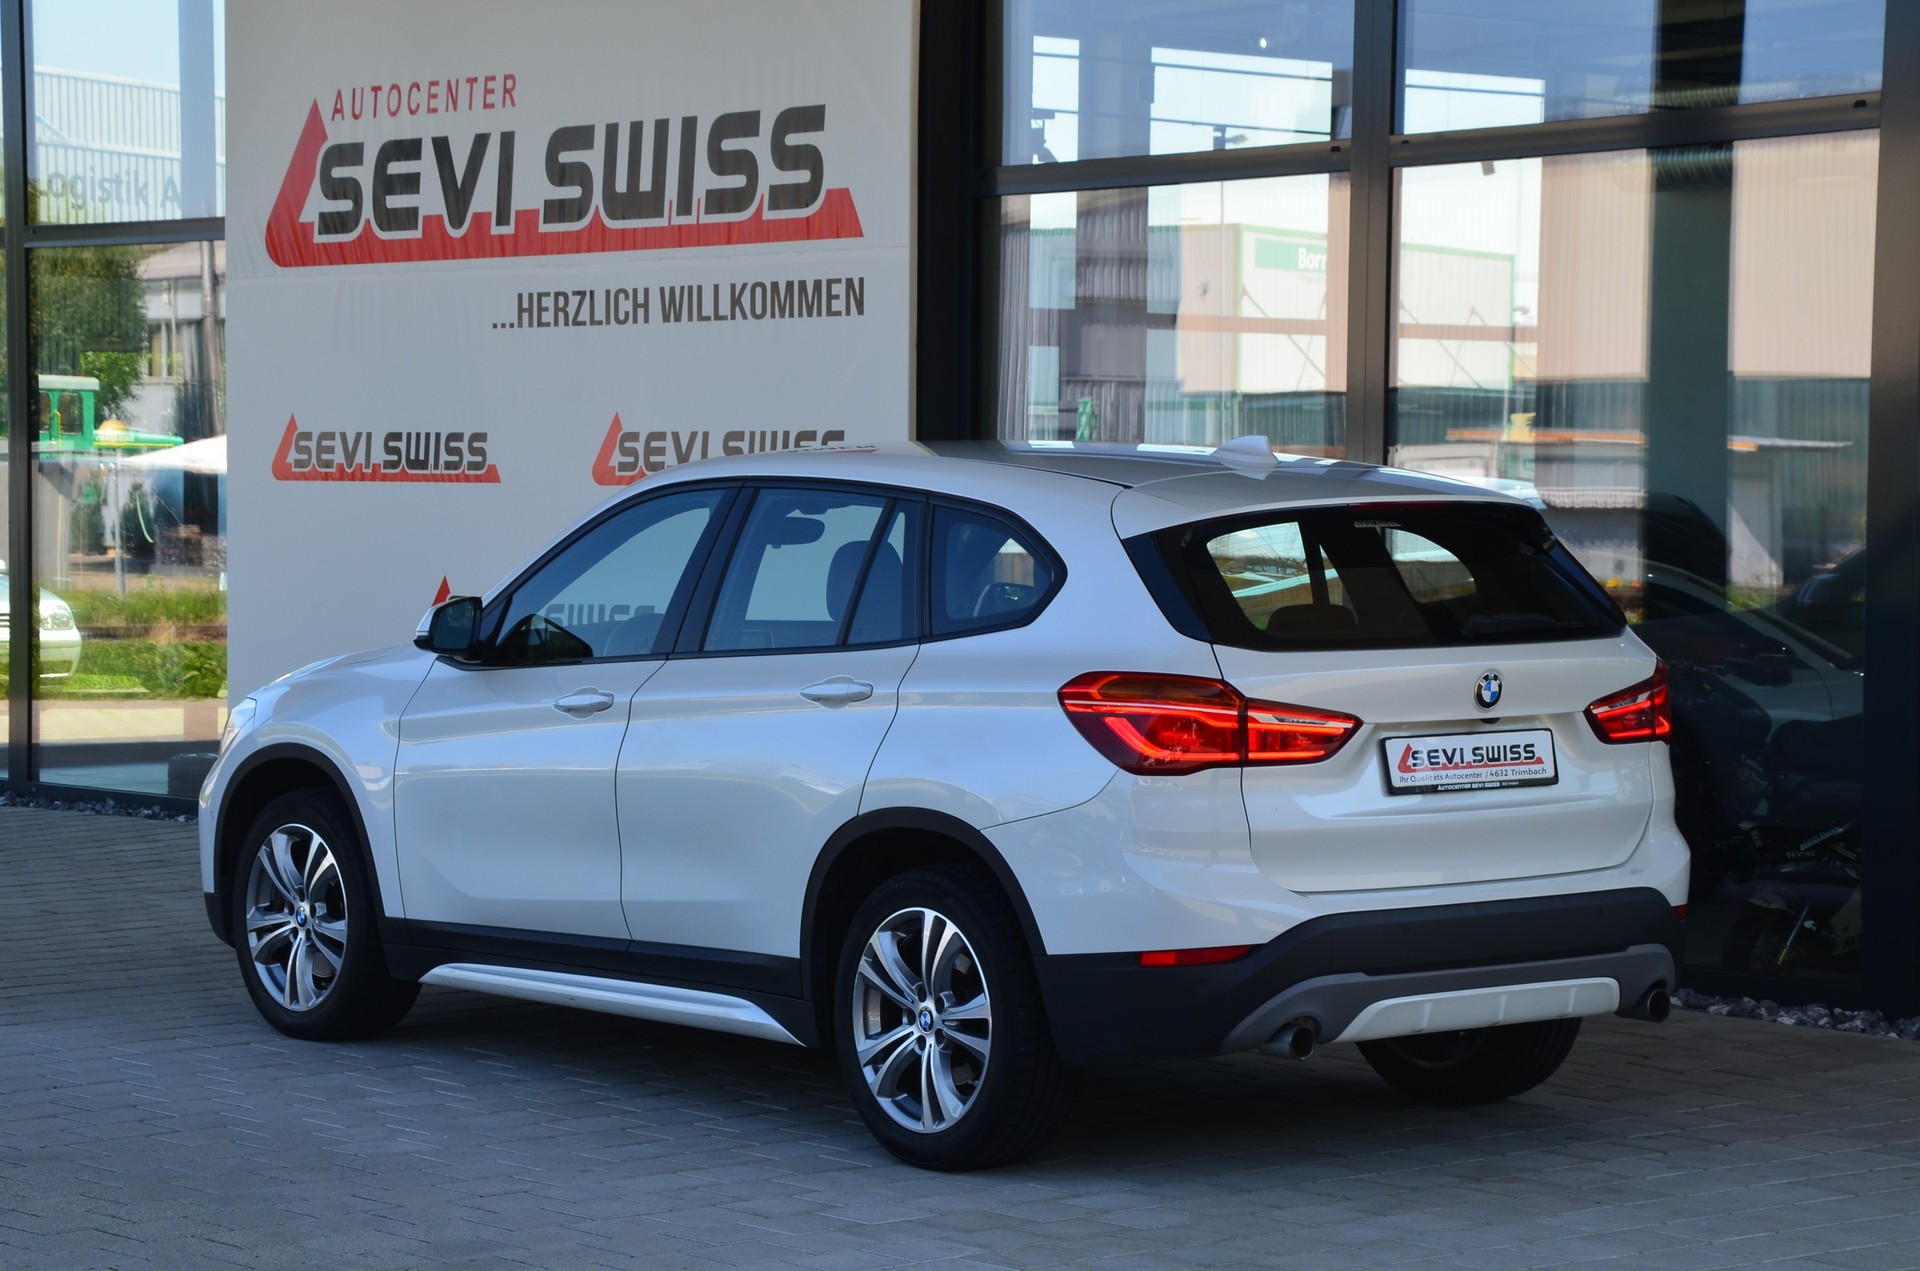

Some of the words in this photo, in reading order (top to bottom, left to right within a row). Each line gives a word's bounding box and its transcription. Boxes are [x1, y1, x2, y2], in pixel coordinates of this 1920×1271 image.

[331, 73, 517, 121] AUTOCENTER
[317, 130, 515, 236] SEVI
[539, 104, 826, 225] SWISS
[659, 277, 865, 324] WILLKOMMEN
[293, 432, 372, 471] SEVI
[383, 432, 487, 472] SWISS
[617, 431, 709, 473] SEVI
[1411, 748, 1465, 768] SEVI
[1472, 743, 1536, 764] SWISS
[1445, 771, 1483, 781] Autocenter
[1490, 769, 1509, 777] 4632
[1511, 767, 1547, 776] Trimbach
